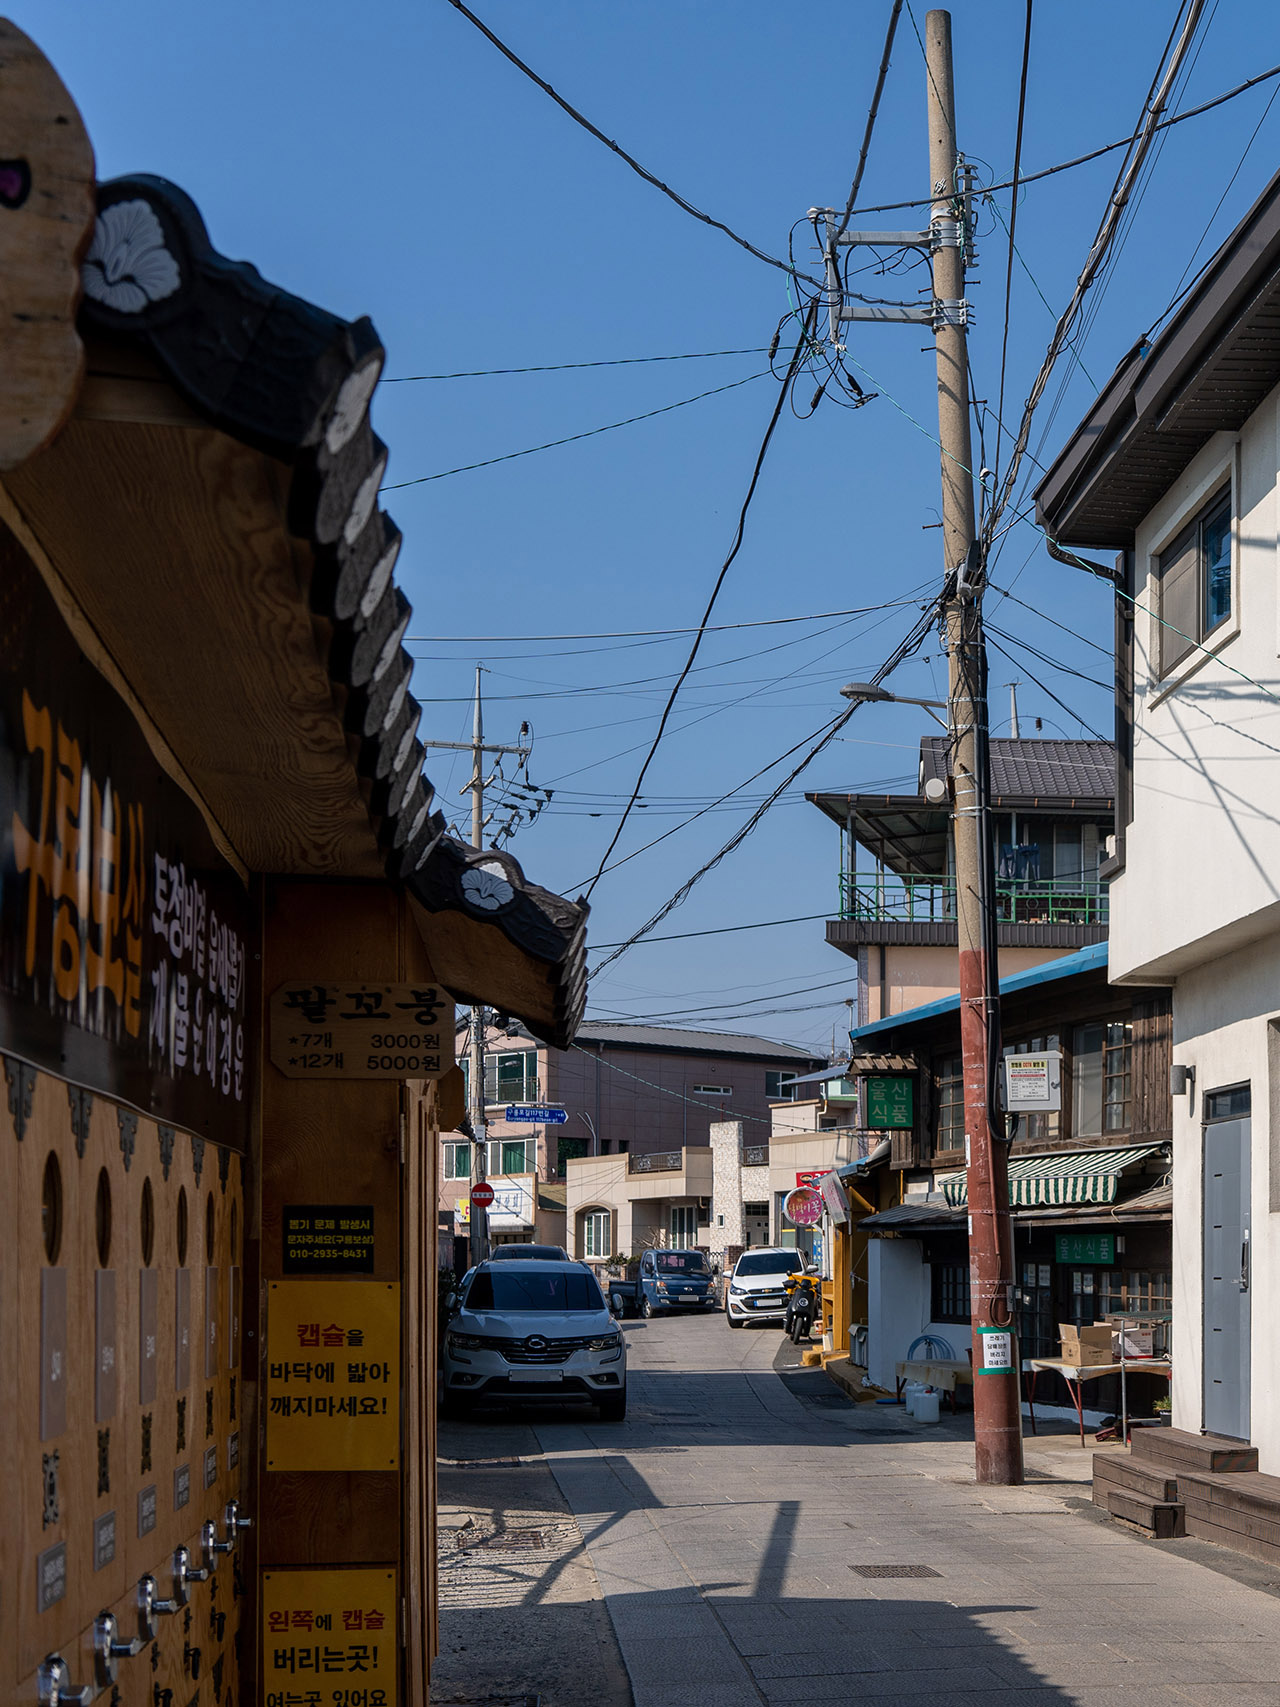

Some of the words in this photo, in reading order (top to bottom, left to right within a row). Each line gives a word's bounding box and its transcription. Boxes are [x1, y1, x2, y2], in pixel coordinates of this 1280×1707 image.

[151, 851, 206, 979] 토정비결
[209, 908, 245, 1016] 운세뽑기
[370, 1034, 440, 1050] 3000원
[367, 1055, 441, 1072] 5000원
[871, 1081, 909, 1101] 울산
[872, 1104, 909, 1123] 식품
[289, 1219, 310, 1230] 뽑기
[314, 1219, 336, 1230] 문제
[339, 1219, 371, 1230] 발생시
[289, 1249, 367, 1258] 010-2935-8431
[1060, 1238, 1109, 1259] 울산식품
[297, 1324, 364, 1347] 캡슐을
[270, 1362, 334, 1383] 바닥에
[347, 1362, 390, 1383] 밟아
[270, 1396, 387, 1416] 깨지마세요!
[268, 1610, 332, 1633] 왼쪽에
[342, 1609, 385, 1631] 캡슐
[274, 1646, 378, 1674] 버리는곳!
